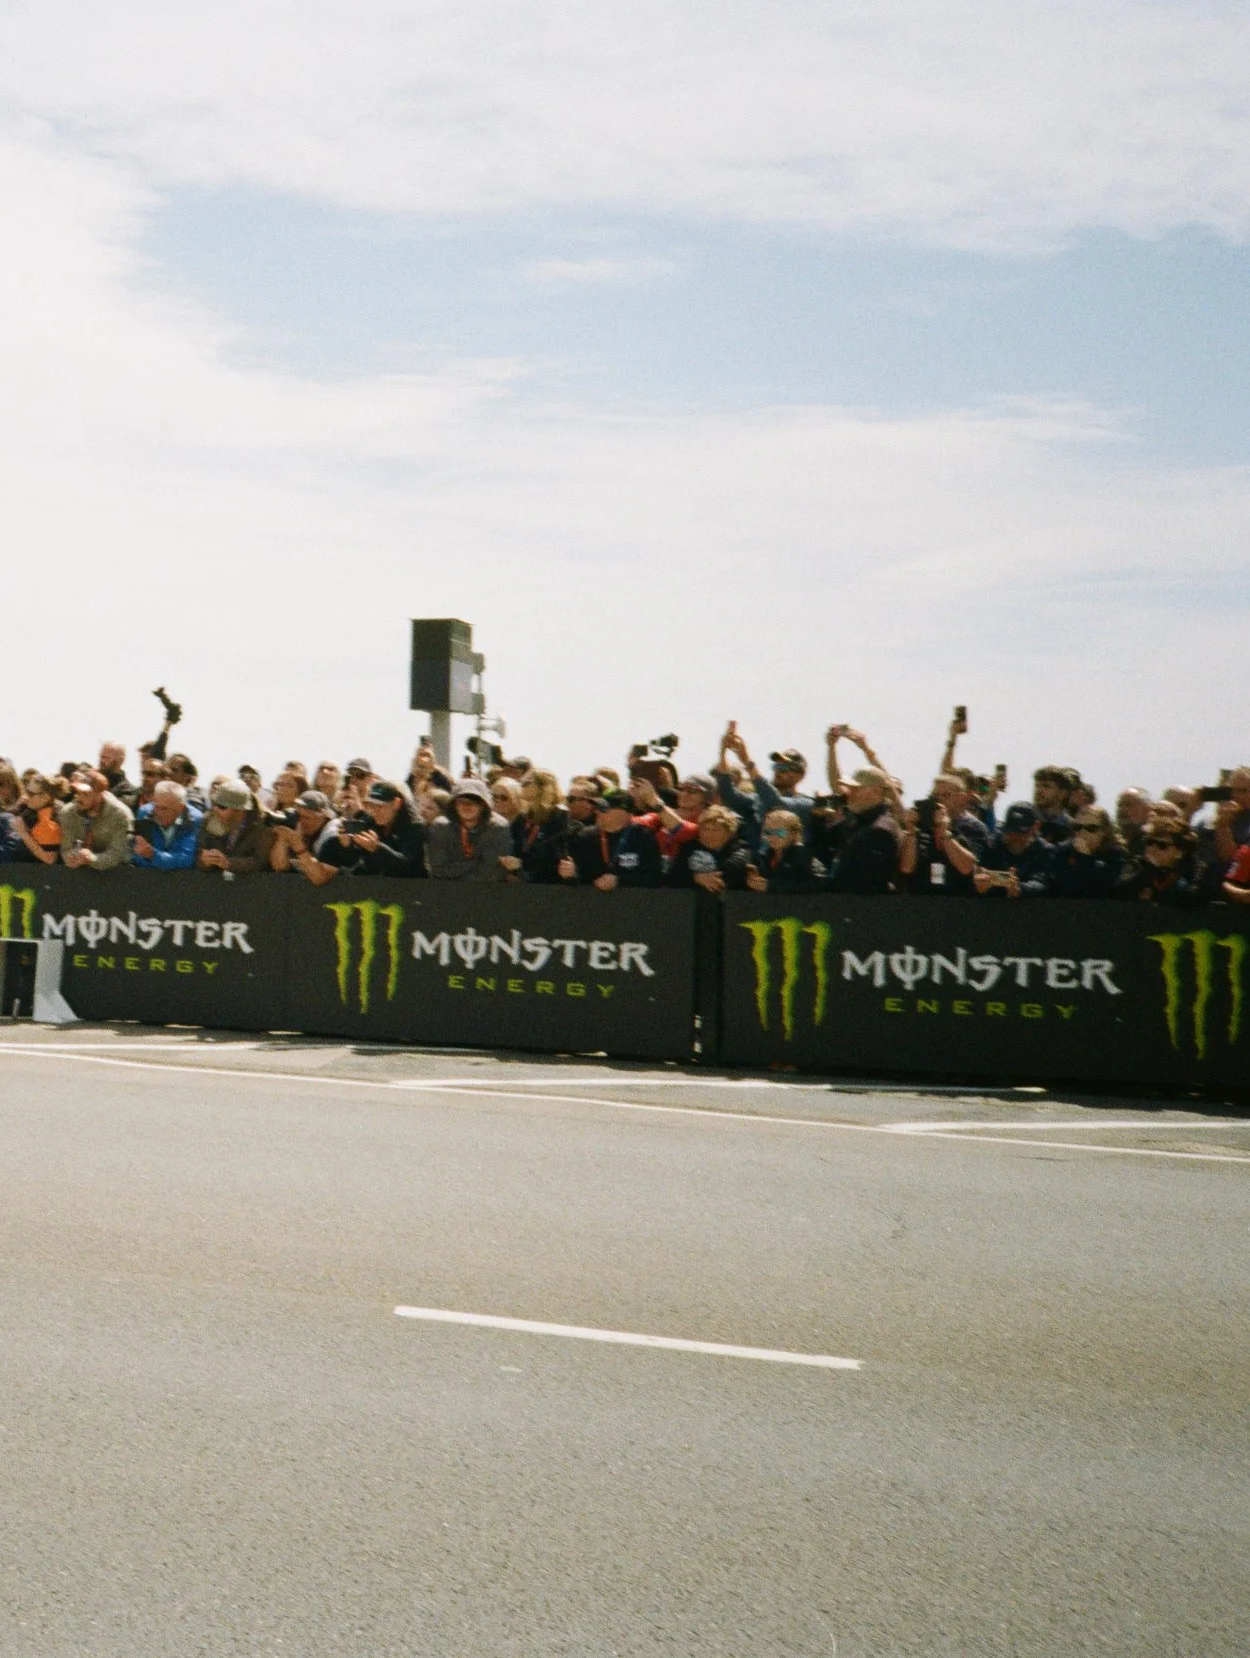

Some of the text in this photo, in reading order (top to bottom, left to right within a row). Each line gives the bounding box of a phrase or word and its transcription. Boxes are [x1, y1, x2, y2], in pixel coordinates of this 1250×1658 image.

[41, 909, 254, 954] MONSTER
[72, 954, 220, 974] ENERGY
[412, 927, 655, 977] MONSTER
[447, 974, 616, 999] ENERGY
[841, 945, 1122, 995] MONSTER
[884, 998, 1079, 1021] ENERGY
